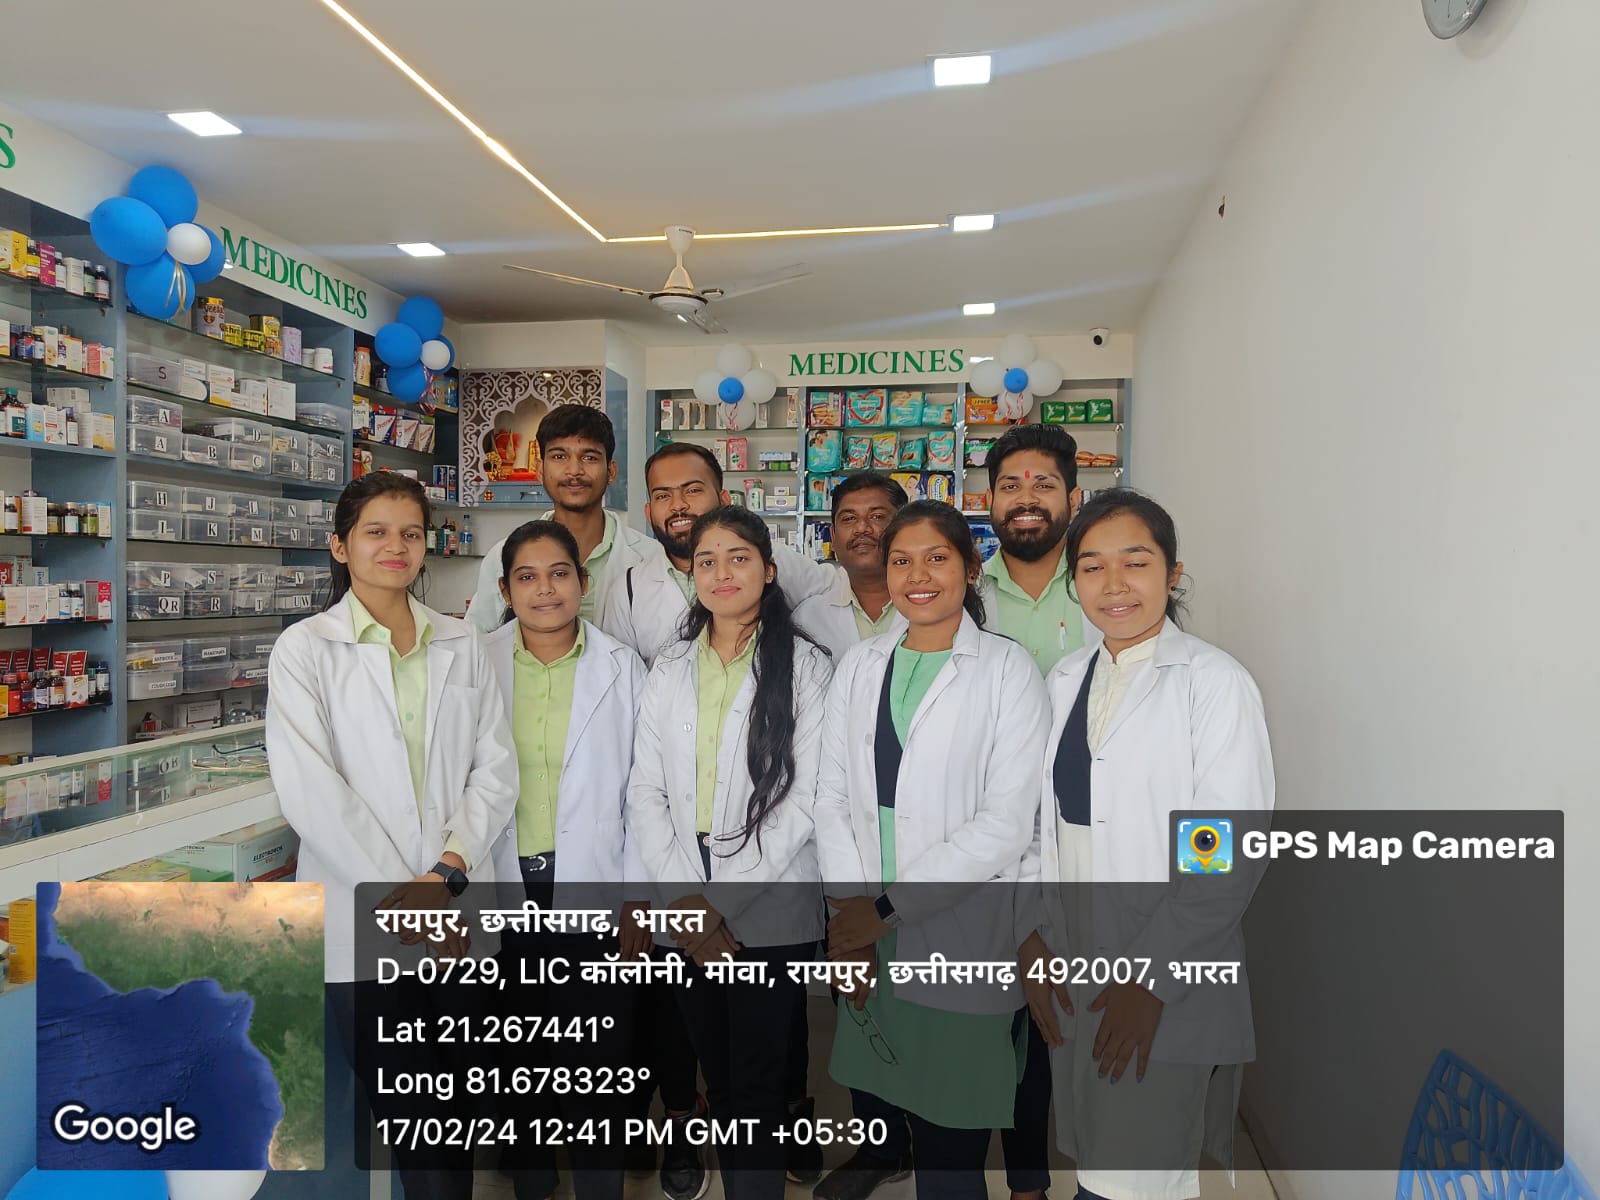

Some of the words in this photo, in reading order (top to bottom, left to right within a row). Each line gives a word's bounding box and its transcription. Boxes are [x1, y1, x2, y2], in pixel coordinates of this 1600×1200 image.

[220, 226, 367, 319] MEDICINES
[788, 349, 964, 376] MEDICINES
[158, 366, 167, 380] S
[159, 410, 169, 423] A
[156, 438, 165, 450] A
[209, 446, 216, 458] B
[253, 456, 262, 467] C
[157, 492, 166, 505] H
[207, 497, 214, 510] J
[160, 521, 166, 534] I
[208, 523, 217, 536] K
[163, 573, 170, 584] P
[208, 571, 215, 583] S
[212, 598, 220, 611] R
[256, 599, 263, 610] T
